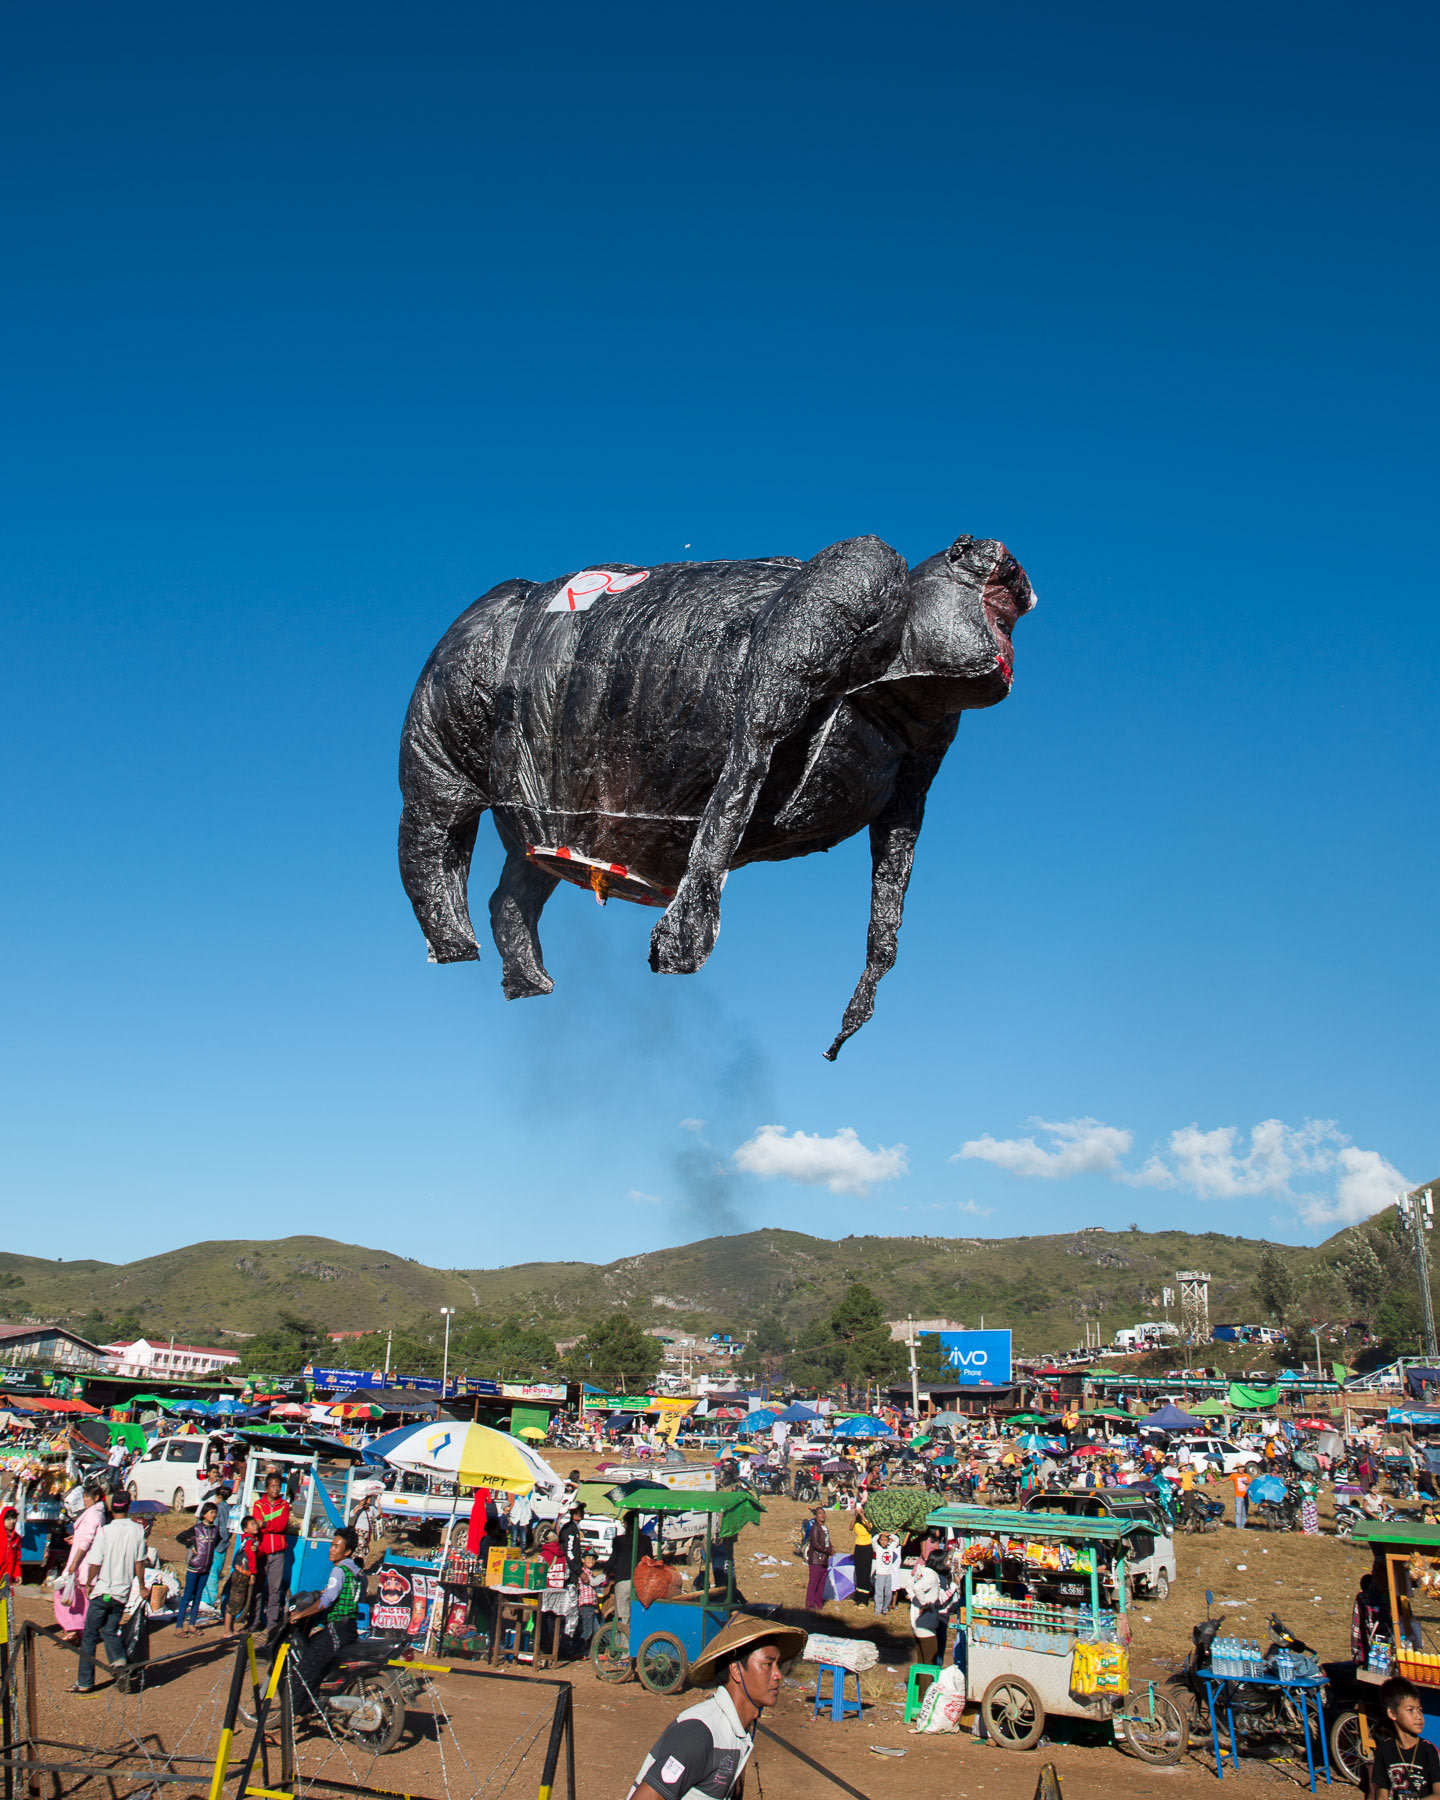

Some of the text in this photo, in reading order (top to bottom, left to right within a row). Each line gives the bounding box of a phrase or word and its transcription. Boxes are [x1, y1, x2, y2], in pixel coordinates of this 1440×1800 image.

[1143, 1326, 1163, 1336] MPT
[963, 1368, 982, 1376] Phone
[481, 1474, 509, 1487] MPT
[380, 1606, 410, 1614] MISTER
